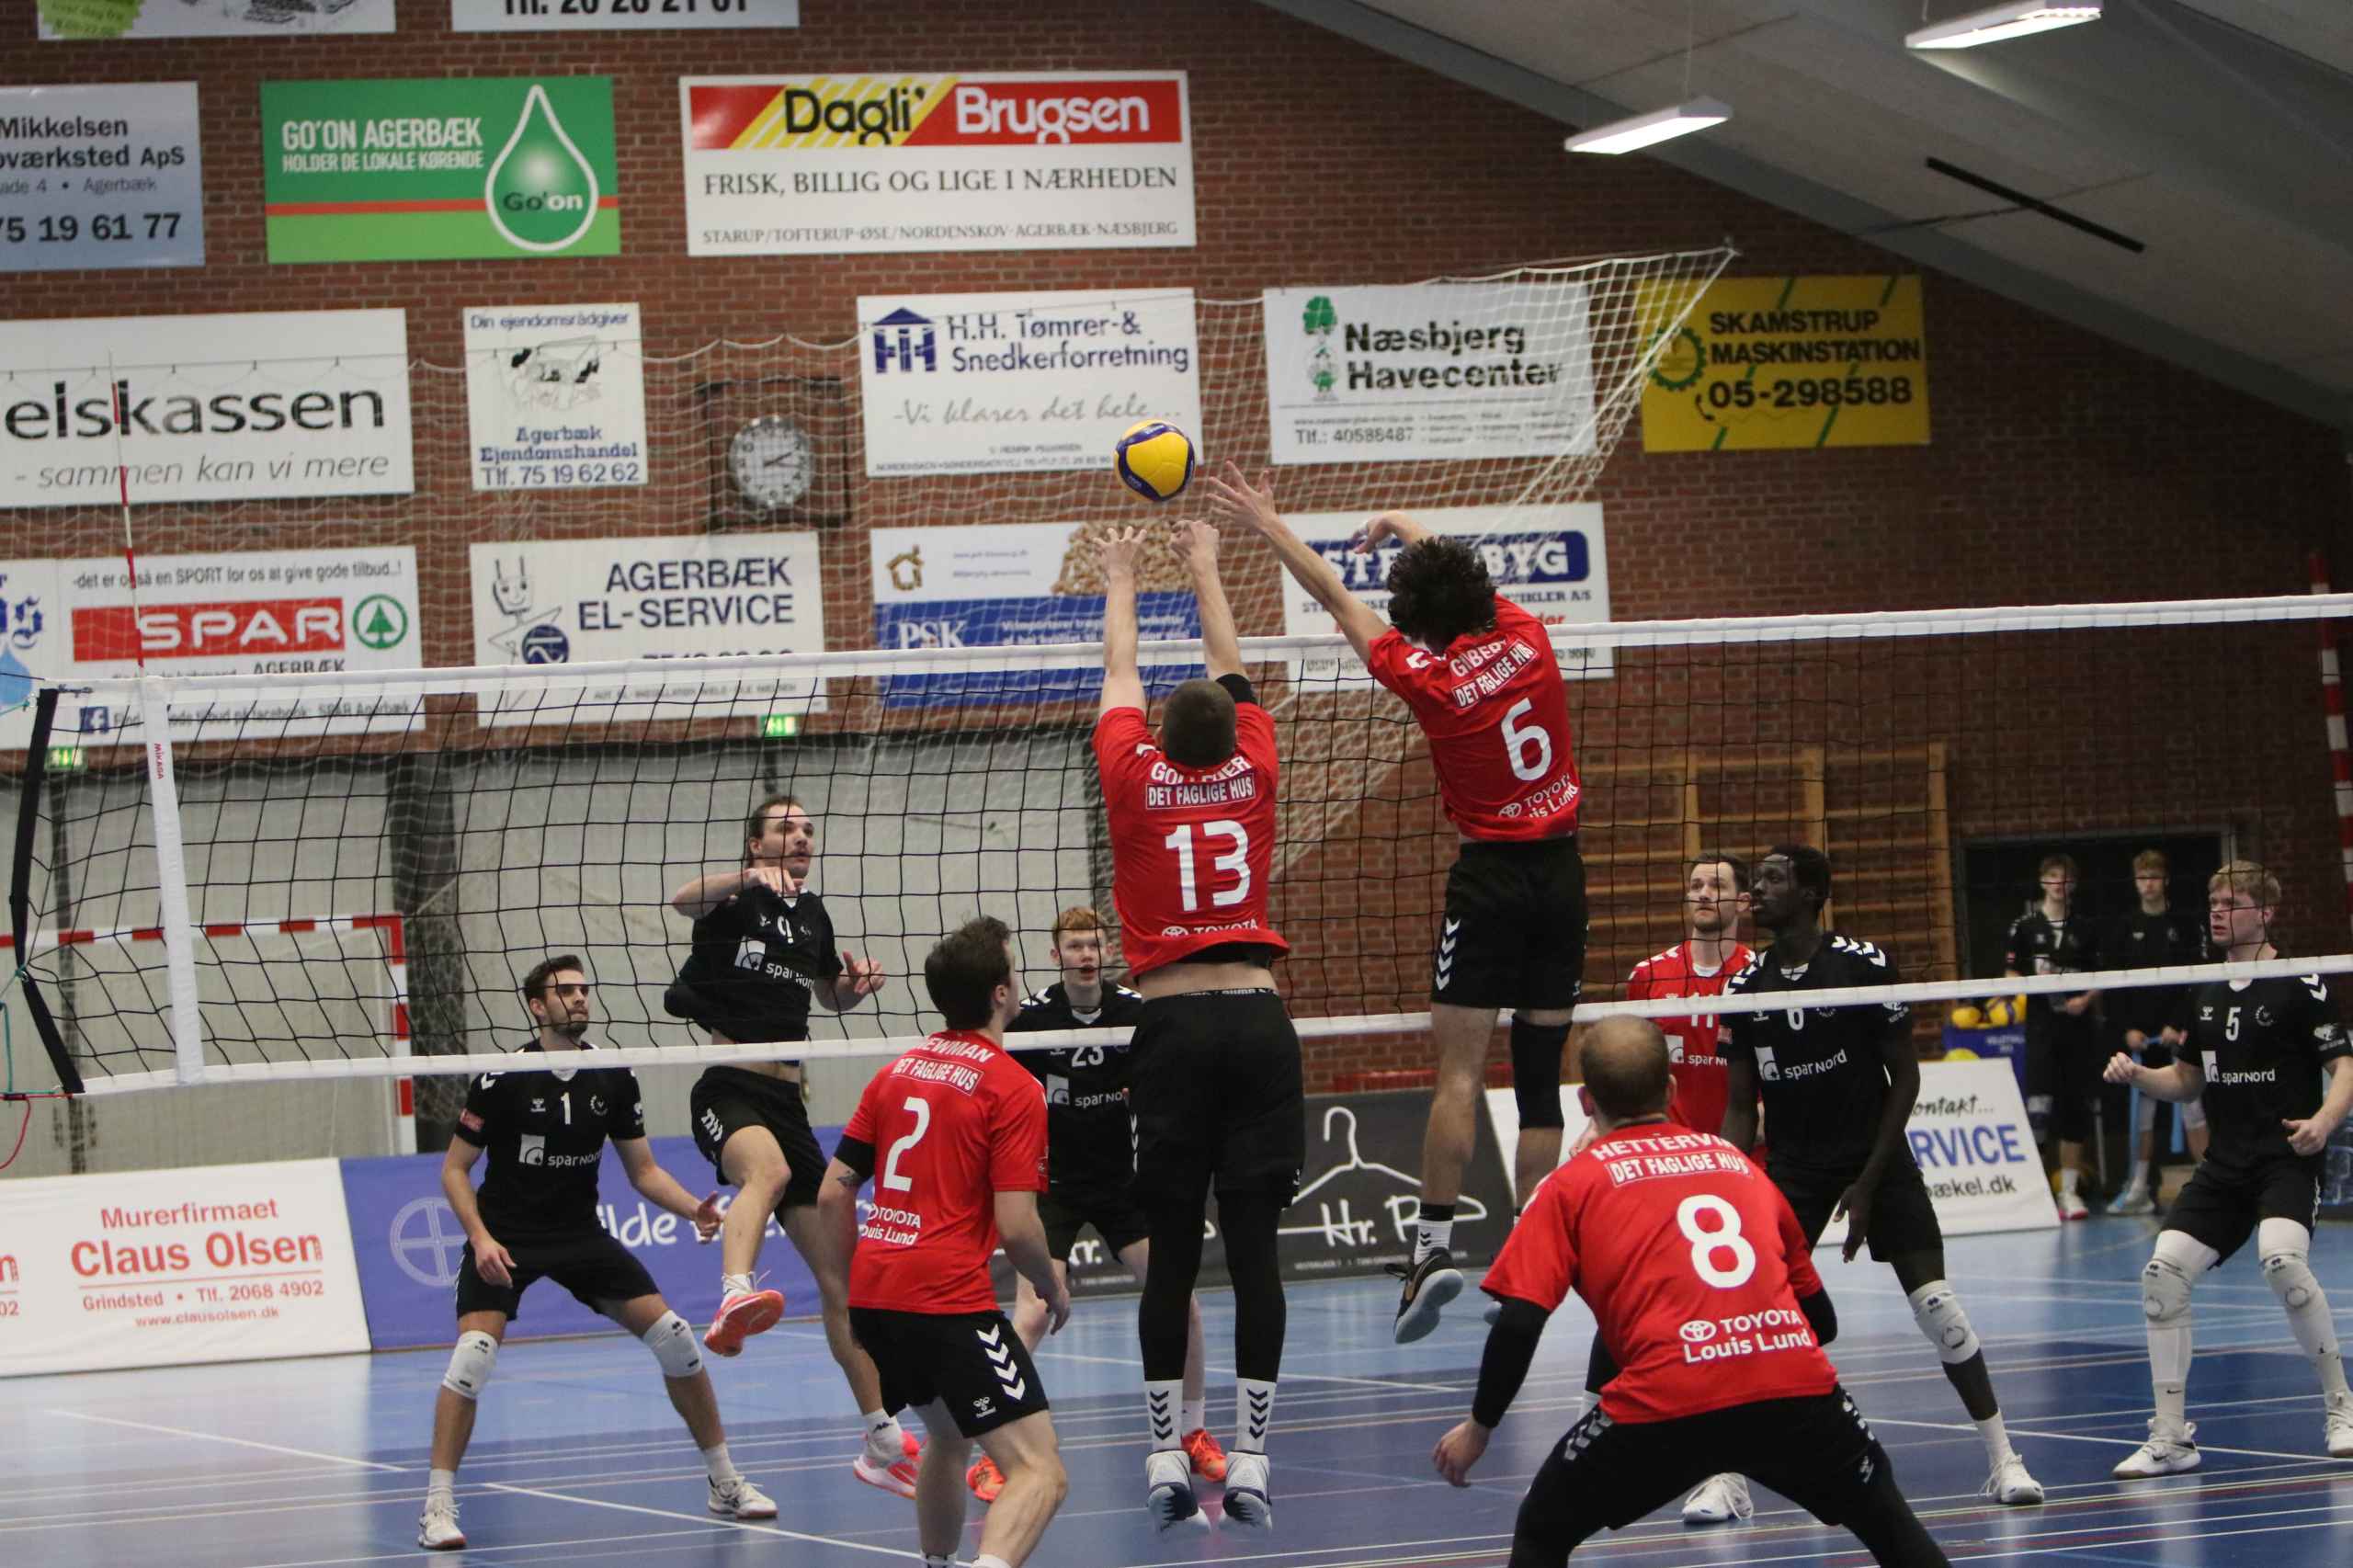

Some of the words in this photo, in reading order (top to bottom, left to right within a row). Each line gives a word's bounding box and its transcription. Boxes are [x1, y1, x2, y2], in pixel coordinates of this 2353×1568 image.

[0, 116, 128, 139] Mikkelsen
[957, 87, 1150, 144] Brugsen
[364, 117, 483, 150] AGERBÆK
[141, 145, 185, 170] ApS
[282, 153, 338, 173] HOLDER
[342, 152, 359, 172] DE
[363, 151, 416, 171] LOKALE
[418, 149, 483, 170] KØRENDE
[704, 173, 786, 197] FRISK,
[794, 170, 880, 194] BILLIG
[889, 170, 928, 192] OG
[938, 169, 995, 191] LIGE
[1006, 168, 1014, 190] I
[1024, 166, 1178, 189] NÆRHEDEN
[0, 216, 26, 243] 5
[39, 215, 78, 243] 19
[92, 213, 132, 241] 61
[143, 211, 181, 240] 77
[1710, 309, 1880, 334] SKAMSTRUP
[1344, 320, 1526, 356] Næsbjerg
[1711, 337, 1920, 365] MASKINSTATION
[951, 341, 1189, 373] Snedkerforretning
[1347, 359, 1562, 391] Havecenter
[1709, 375, 1912, 409] 05-298588
[516, 424, 602, 444] Agerbæk
[197, 454, 255, 484] kan
[268, 451, 293, 480] vi
[304, 455, 389, 479] mere
[480, 442, 638, 464] Ejendomshandel
[520, 465, 546, 485] 75
[552, 464, 574, 483] 19
[579, 463, 607, 483] 62
[610, 462, 639, 482] 62
[176, 566, 222, 584] SPORT
[606, 556, 792, 594] AGERBÆK
[140, 606, 341, 651] SPAR
[578, 594, 795, 631] EL-SERVICE
[898, 619, 966, 649] PSK
[1501, 697, 1552, 781] 6
[1148, 786, 1172, 806] DET
[1176, 782, 1228, 805] FAGLIGE
[1229, 776, 1253, 800] HUS
[1165, 818, 1251, 912] 13
[2225, 1006, 2242, 1041] 5
[926, 1037, 995, 1063] EWMAN
[1071, 1045, 1104, 1068] 23
[949, 1065, 979, 1091] HUS
[560, 1091, 572, 1126] 1
[882, 1096, 931, 1192] 2
[1907, 1123, 2027, 1170] RVICE
[1609, 1158, 1644, 1183] DET
[1645, 1153, 1716, 1176] FAGLIGE
[1715, 1152, 1750, 1175] HUS
[100, 1198, 278, 1230] Murerfirmaet
[878, 1207, 922, 1229] TOYOTA
[1321, 1199, 1377, 1246] Hr.
[858, 1223, 883, 1240] ouis
[884, 1226, 919, 1246] Lund
[1677, 1194, 1756, 1289] 8
[71, 1239, 190, 1278] Claus
[206, 1230, 324, 1267] Olsen
[83, 1290, 164, 1312] Grindsted
[196, 1288, 224, 1304] Tlf.
[231, 1284, 274, 1302] 2068
[279, 1280, 324, 1299] 4902
[134, 1306, 279, 1329] www.clausolsen.dk
[1720, 1309, 1803, 1335] TOYOTA
[1683, 1336, 1753, 1364] Louis
[1756, 1329, 1813, 1352] Lund
